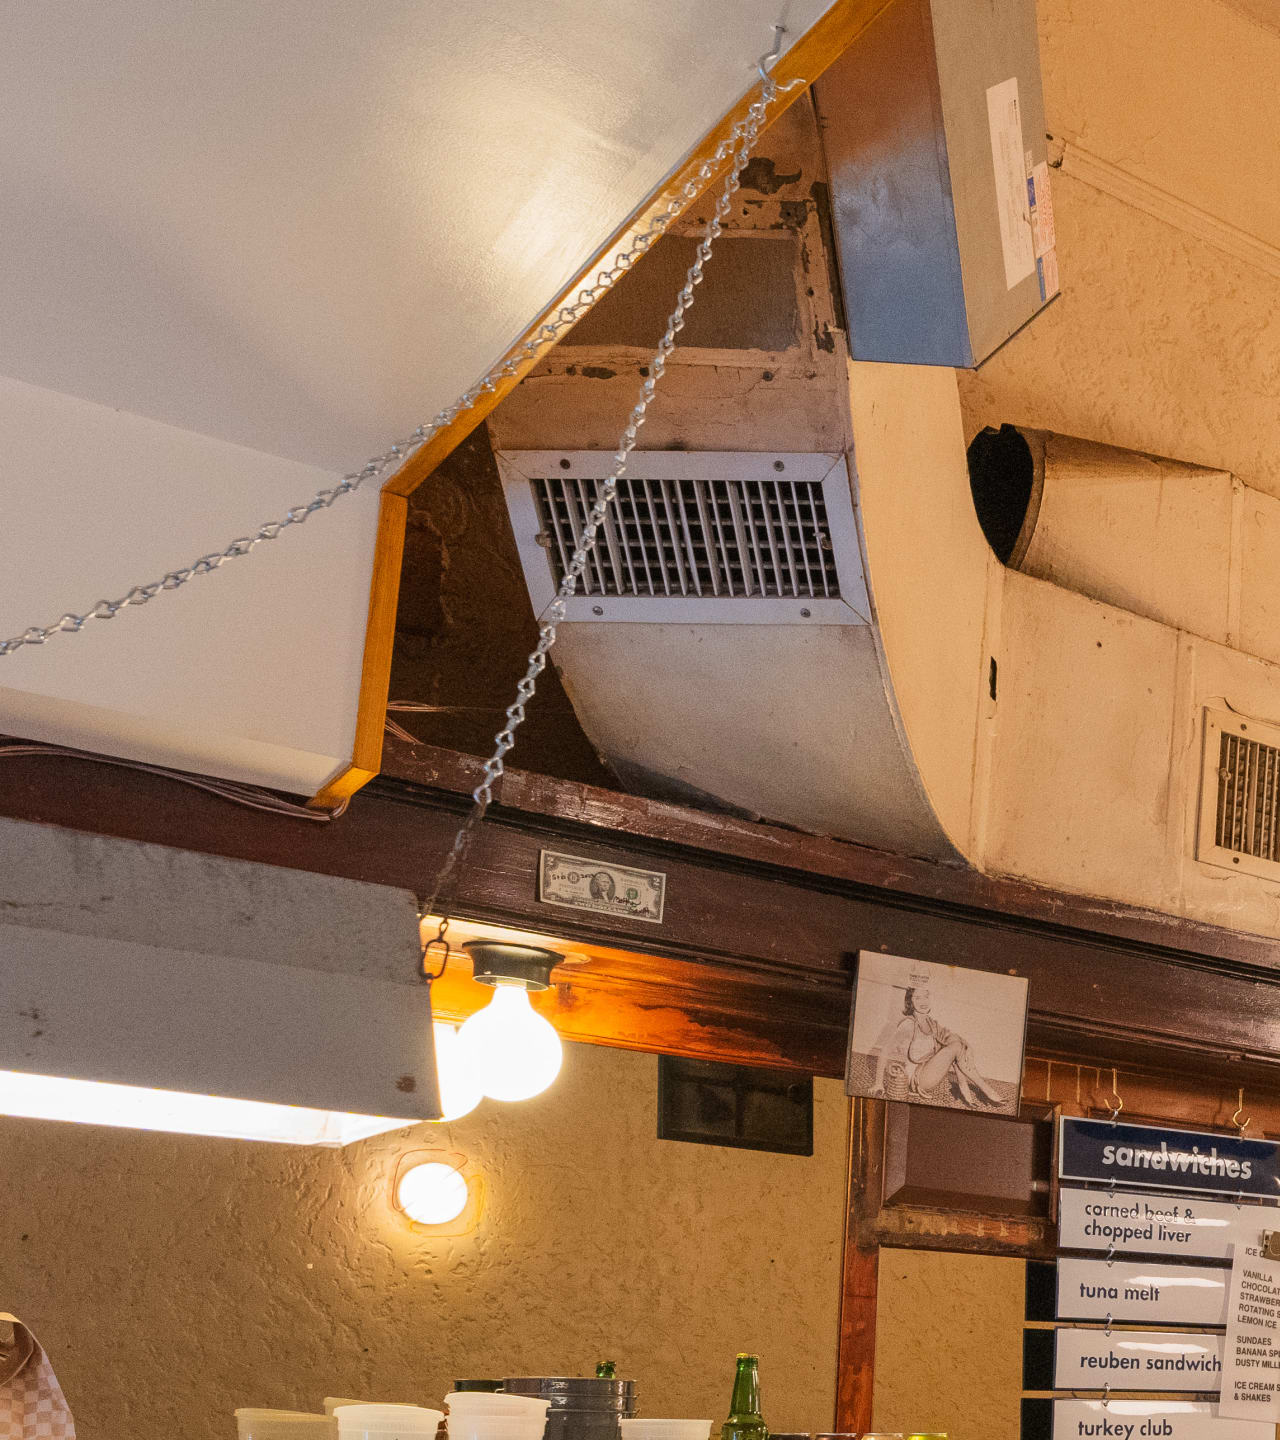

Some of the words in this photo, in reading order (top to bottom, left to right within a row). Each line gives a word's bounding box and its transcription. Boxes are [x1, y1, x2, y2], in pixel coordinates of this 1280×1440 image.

[1102, 1142, 1252, 1179] sandwiches
[1085, 1203, 1139, 1219] corned
[1145, 1203, 1178, 1223] beef
[1184, 1208, 1196, 1224] &
[1084, 1220, 1152, 1242] chopped
[1158, 1224, 1192, 1242] liver
[1245, 1247, 1257, 1257] ICE
[1243, 1270, 1273, 1283] VANILLA
[1080, 1283, 1118, 1299] tuna
[1125, 1286, 1160, 1301] melt
[1238, 1304, 1275, 1318] ROTATING
[1237, 1316, 1264, 1327] LEMON
[1265, 1320, 1277, 1329] ICE
[1236, 1336, 1272, 1346] SUNDAES
[1236, 1347, 1267, 1357] BANANA
[1080, 1351, 1140, 1370] reuben
[1146, 1354, 1222, 1372] sandwich
[1236, 1359, 1260, 1368] DUSTY
[1234, 1381, 1246, 1390] ICE
[1249, 1382, 1275, 1391] CREAM
[1234, 1393, 1239, 1401] &
[1241, 1394, 1271, 1402] SHAKES
[1078, 1418, 1135, 1440] turkey
[1140, 1419, 1173, 1436] club
